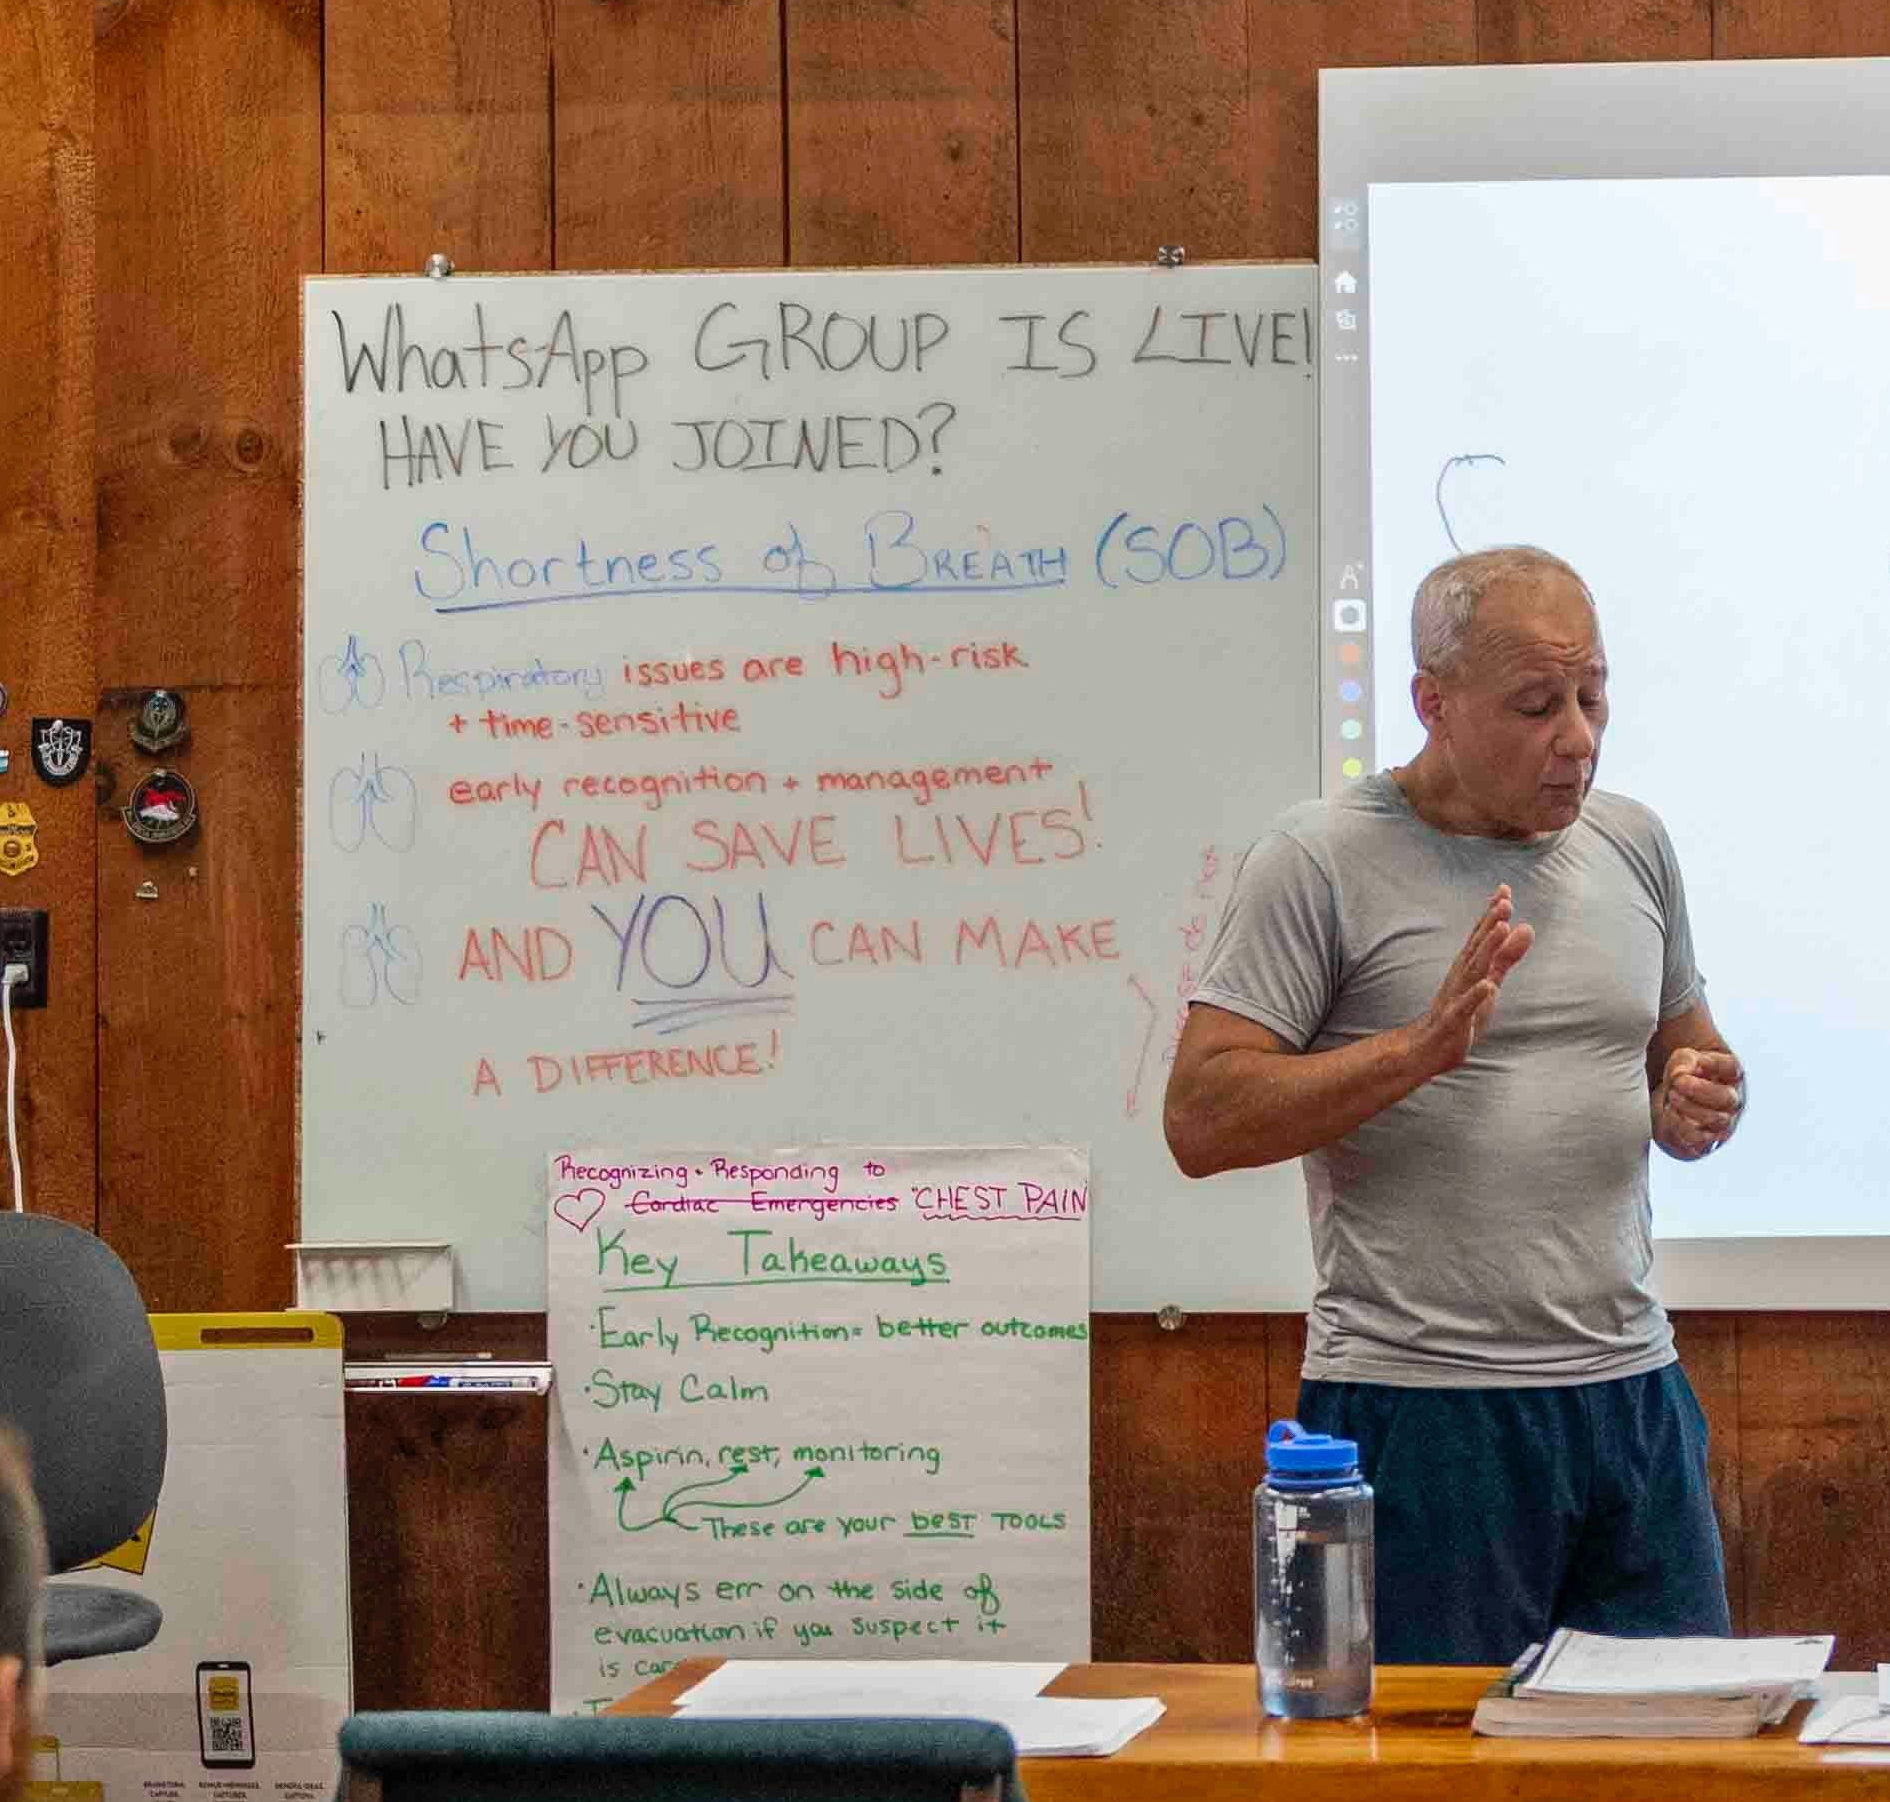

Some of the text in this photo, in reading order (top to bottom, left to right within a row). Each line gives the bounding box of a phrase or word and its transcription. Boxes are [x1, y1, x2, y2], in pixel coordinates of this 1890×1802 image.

[331, 300, 1313, 418] WhatsApp GROUP IS LIVE!
[379, 402, 957, 489] HAVE YOU JOINED?
[415, 522, 723, 600] Shortness
[762, 522, 837, 597] of
[1096, 502, 1287, 590] (SOB)
[622, 653, 726, 687] issues
[743, 652, 803, 684] are
[831, 641, 1030, 699] high-risk
[448, 771, 542, 811] early
[563, 764, 767, 811] recognition
[817, 755, 1054, 805] management
[529, 780, 1103, 889] CAN SAVE LIVES!
[457, 892, 1121, 992] AND YOU CAN MAKE
[472, 1028, 780, 1097] A DIFFERENCE!
[553, 1154, 688, 1190] Recognizing
[711, 1157, 839, 1194] Responding
[862, 1161, 886, 1178] to
[751, 1190, 898, 1222] Emergencies
[596, 1228, 948, 1287] Key Takeaways
[596, 1306, 680, 1355] Early
[876, 1313, 970, 1341] better
[590, 1368, 769, 1412] Stay Calm
[792, 1439, 944, 1475] monitoring
[702, 1516, 775, 1540] These
[784, 1517, 827, 1535] are
[837, 1513, 897, 1540] your
[990, 1511, 1067, 1531] TOOLS
[589, 1571, 1001, 1615] Always err on the side of
[593, 1620, 745, 1647] evacuation
[754, 1615, 779, 1639] if
[793, 1621, 833, 1647] you
[976, 1618, 1008, 1636] it
[598, 1656, 620, 1678] is
